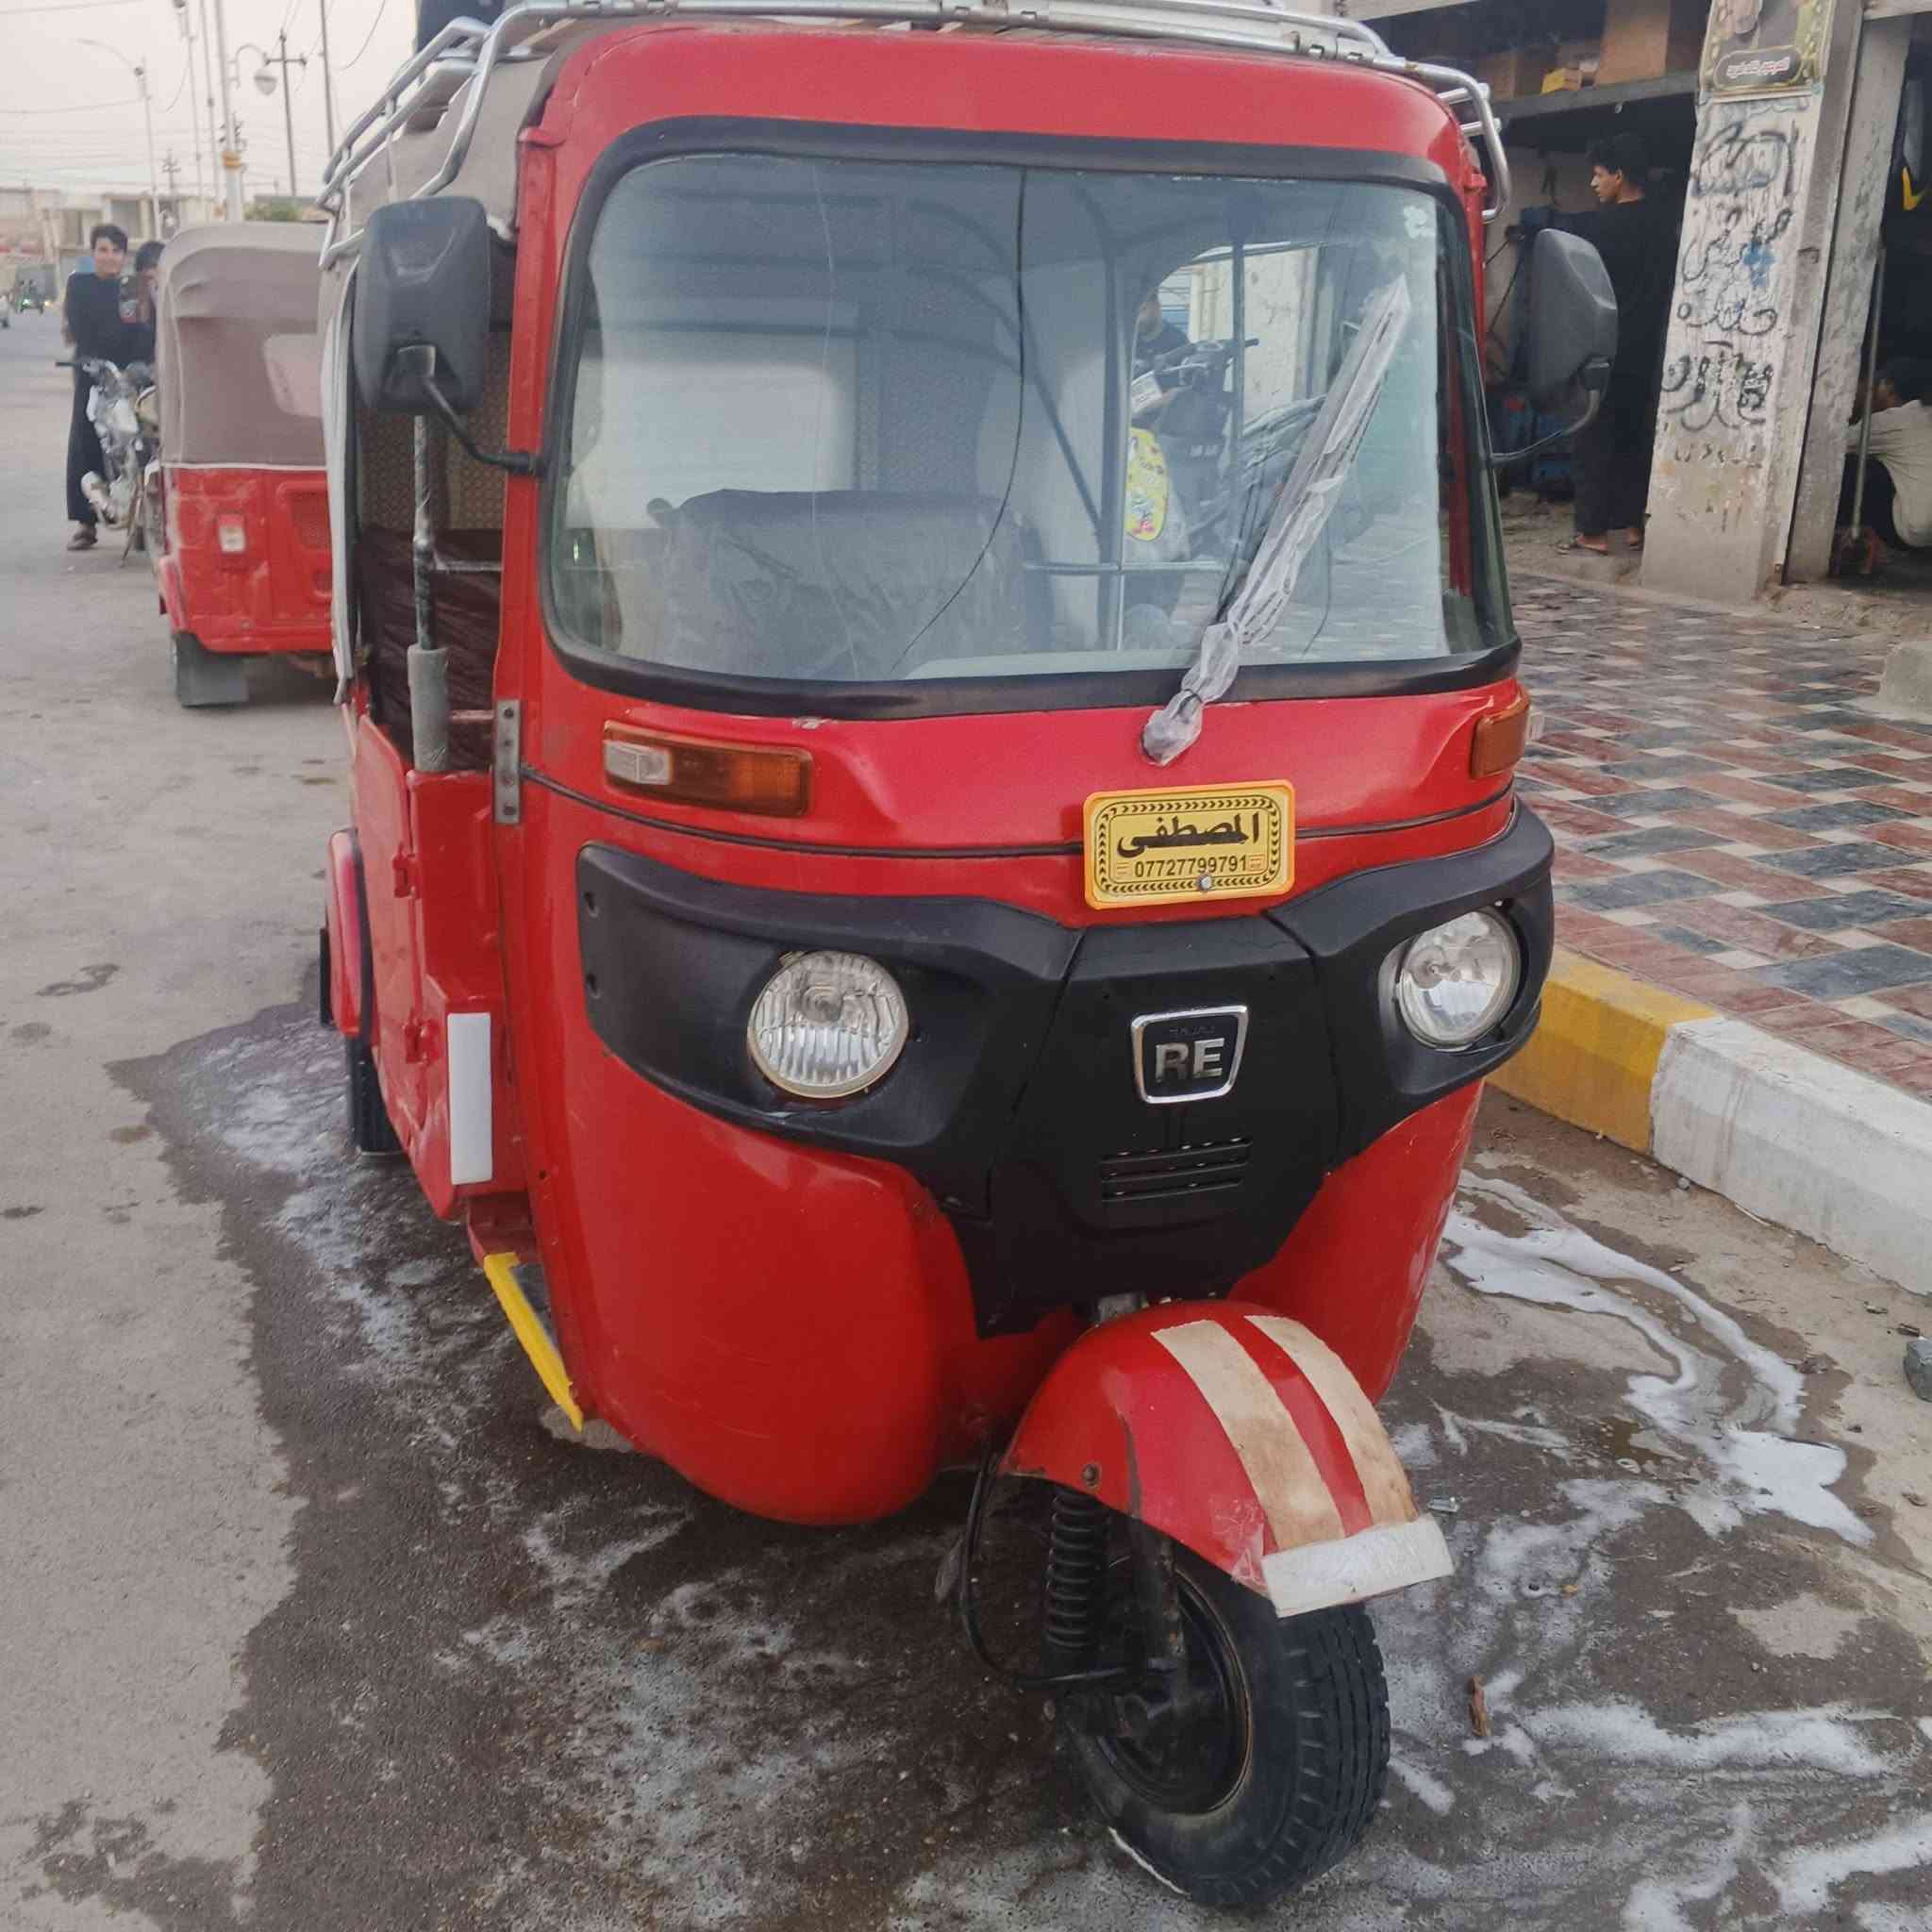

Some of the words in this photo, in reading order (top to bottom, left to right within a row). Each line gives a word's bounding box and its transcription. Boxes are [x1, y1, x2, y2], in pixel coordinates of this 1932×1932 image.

[1117, 811, 1259, 858] المصطفى
[1135, 855, 1246, 877] 07727799791
[1156, 1038, 1224, 1082] RE
